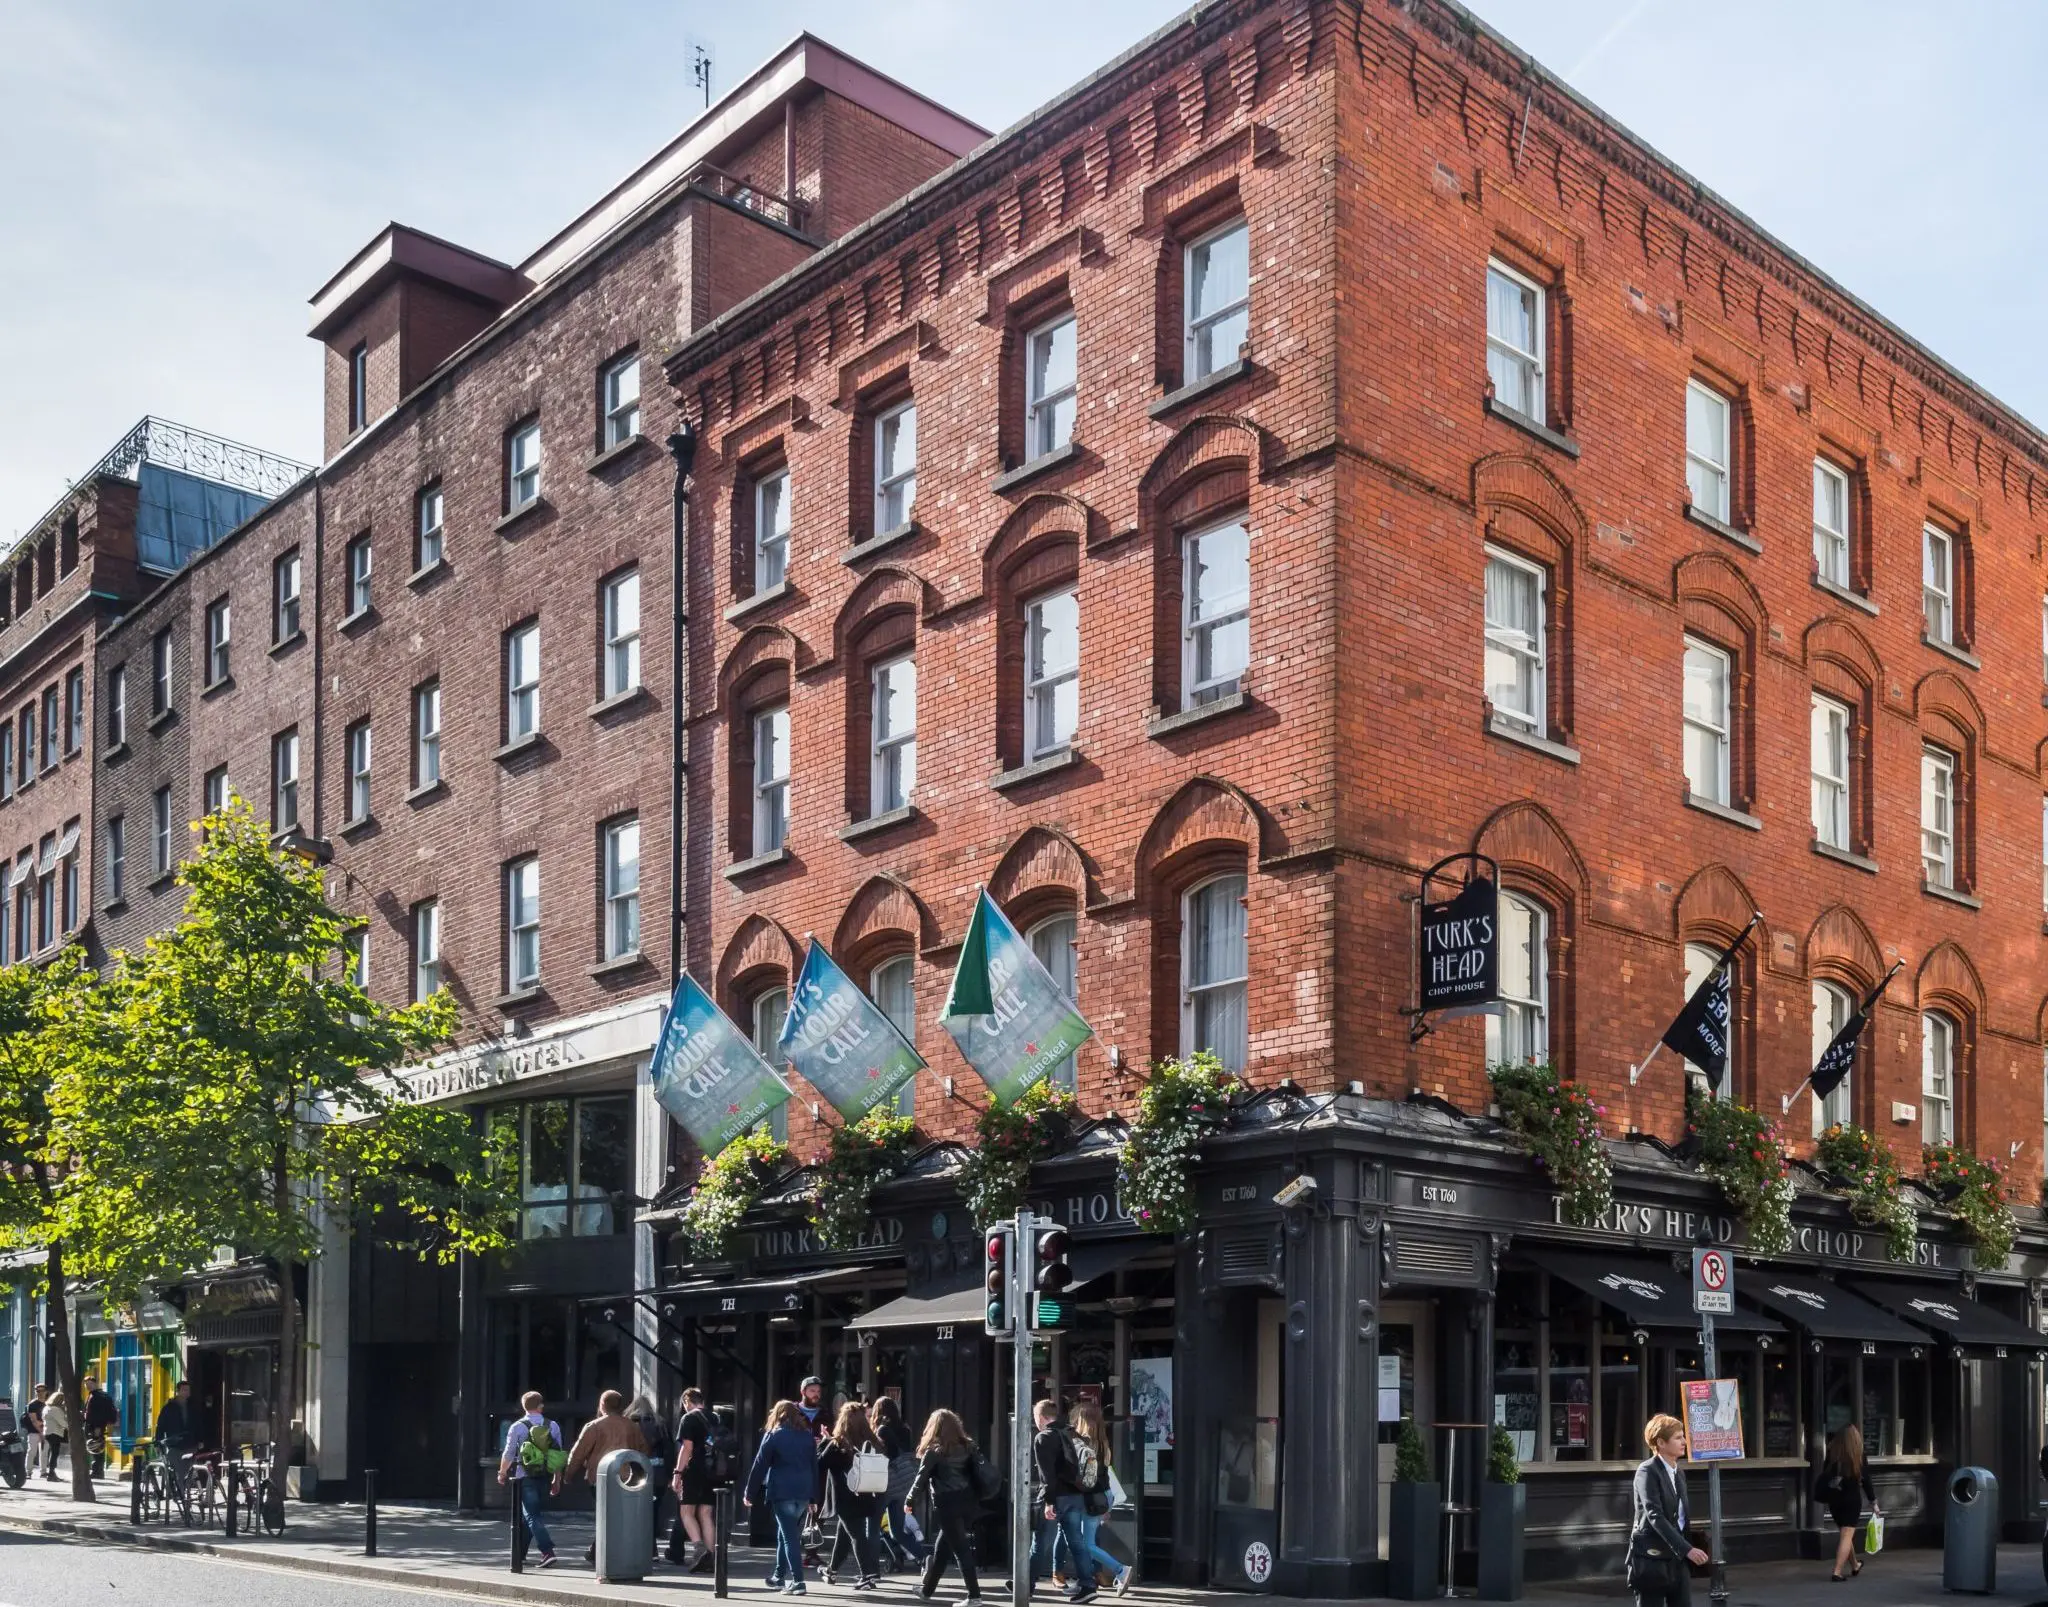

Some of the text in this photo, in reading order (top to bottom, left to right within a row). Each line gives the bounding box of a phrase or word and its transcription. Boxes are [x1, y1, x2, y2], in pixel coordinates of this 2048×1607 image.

[1424, 915, 1493, 952] TURK'S
[1432, 949, 1485, 984] HEAD
[1428, 981, 1486, 997] CHOP HOUSE
[792, 993, 853, 1049] YOUR
[980, 988, 1028, 1037] CALL
[664, 1030, 721, 1082] YOUR
[819, 1020, 871, 1065] CALL
[1696, 1023, 1725, 1056] MORE
[683, 1056, 731, 1100] CALL
[1017, 1038, 1069, 1087] Heineken
[860, 1062, 907, 1109] Heineken
[720, 1101, 769, 1142] Heineken
[1222, 1185, 1257, 1202] EST 1760
[1422, 1186, 1457, 1203] EST 1760
[1552, 1195, 1732, 1243] TRK'S HEAD
[1800, 1227, 1863, 1257] CHOP
[721, 1298, 736, 1311] TH
[937, 1326, 954, 1340] TH
[1862, 1341, 1876, 1354] TH
[1248, 1553, 1267, 1573] 13
